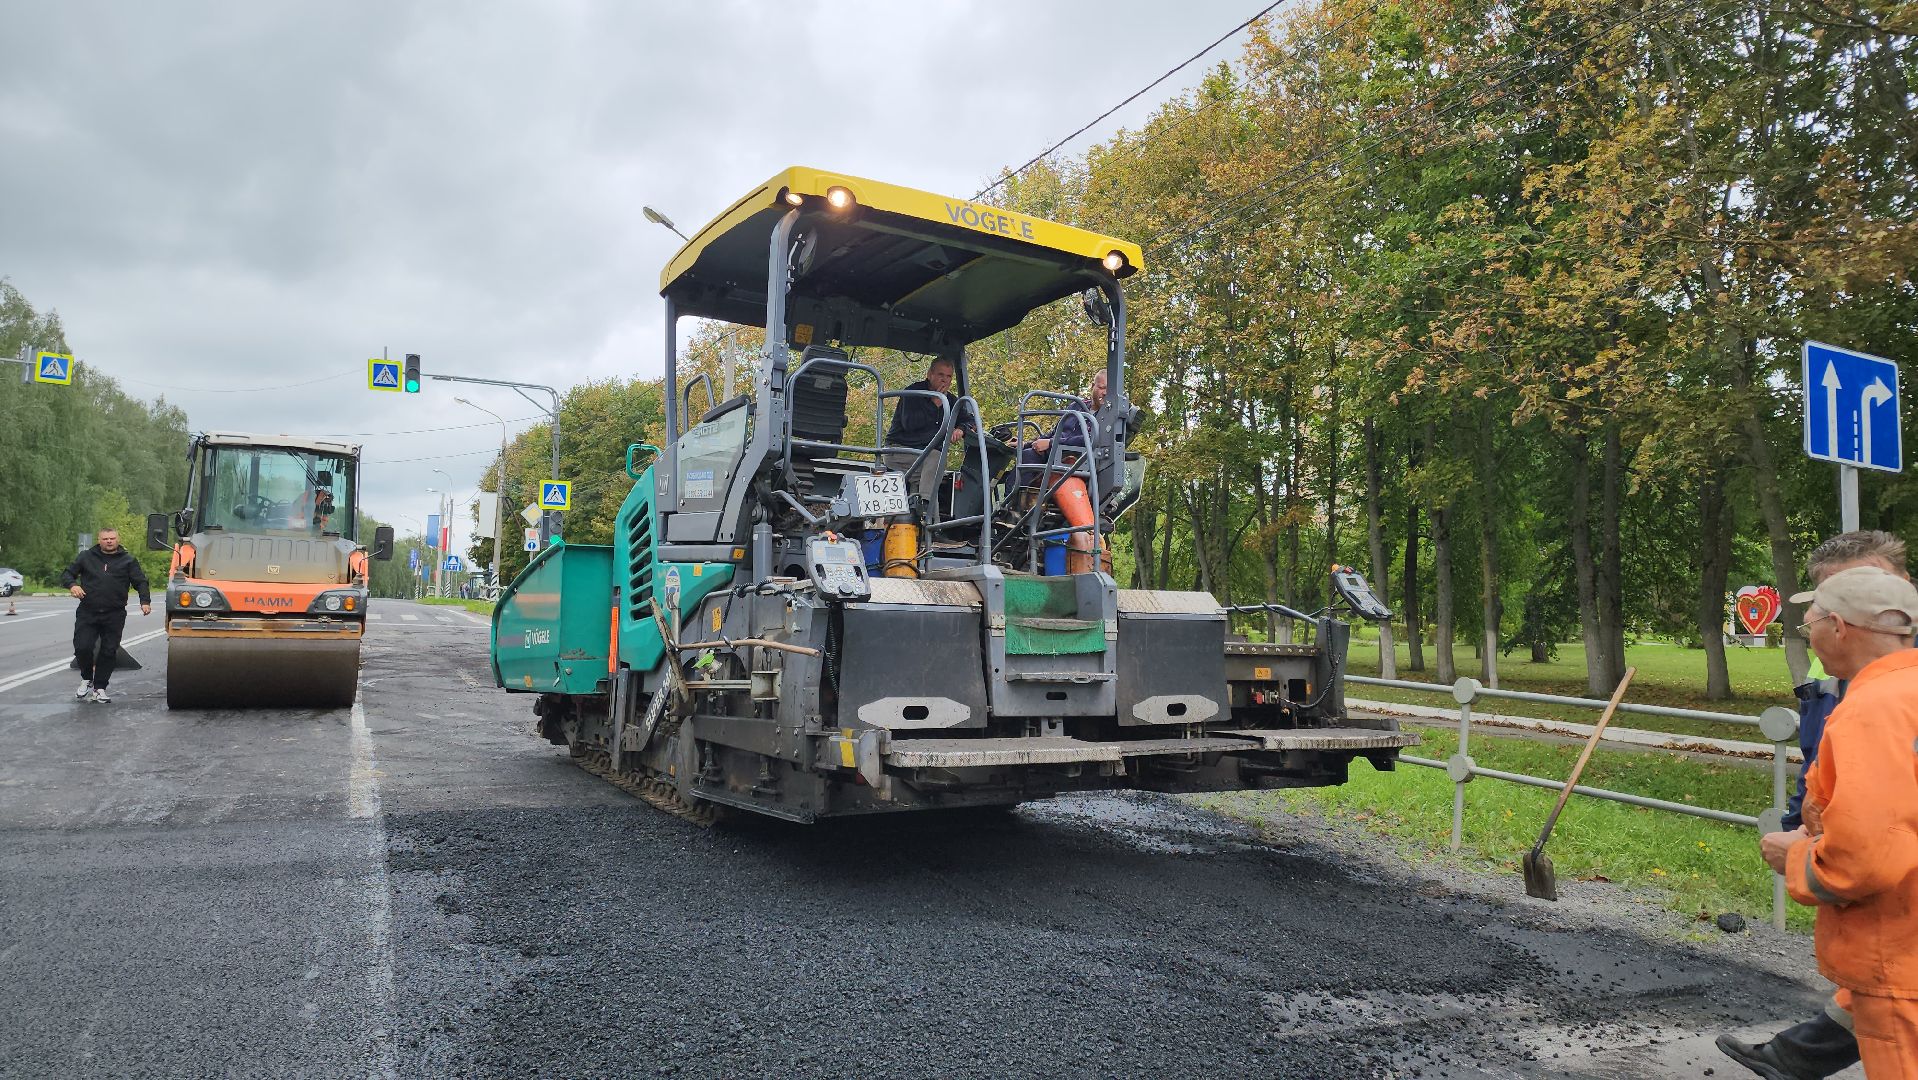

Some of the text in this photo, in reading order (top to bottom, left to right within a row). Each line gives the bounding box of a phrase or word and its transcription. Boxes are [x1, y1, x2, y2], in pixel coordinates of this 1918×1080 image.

[945, 202, 1035, 240] VÖGEE
[864, 478, 899, 494] 1623
[864, 498, 903, 512] ХВ 50
[244, 596, 293, 607] HAMM
[645, 688, 665, 731] SUPER
